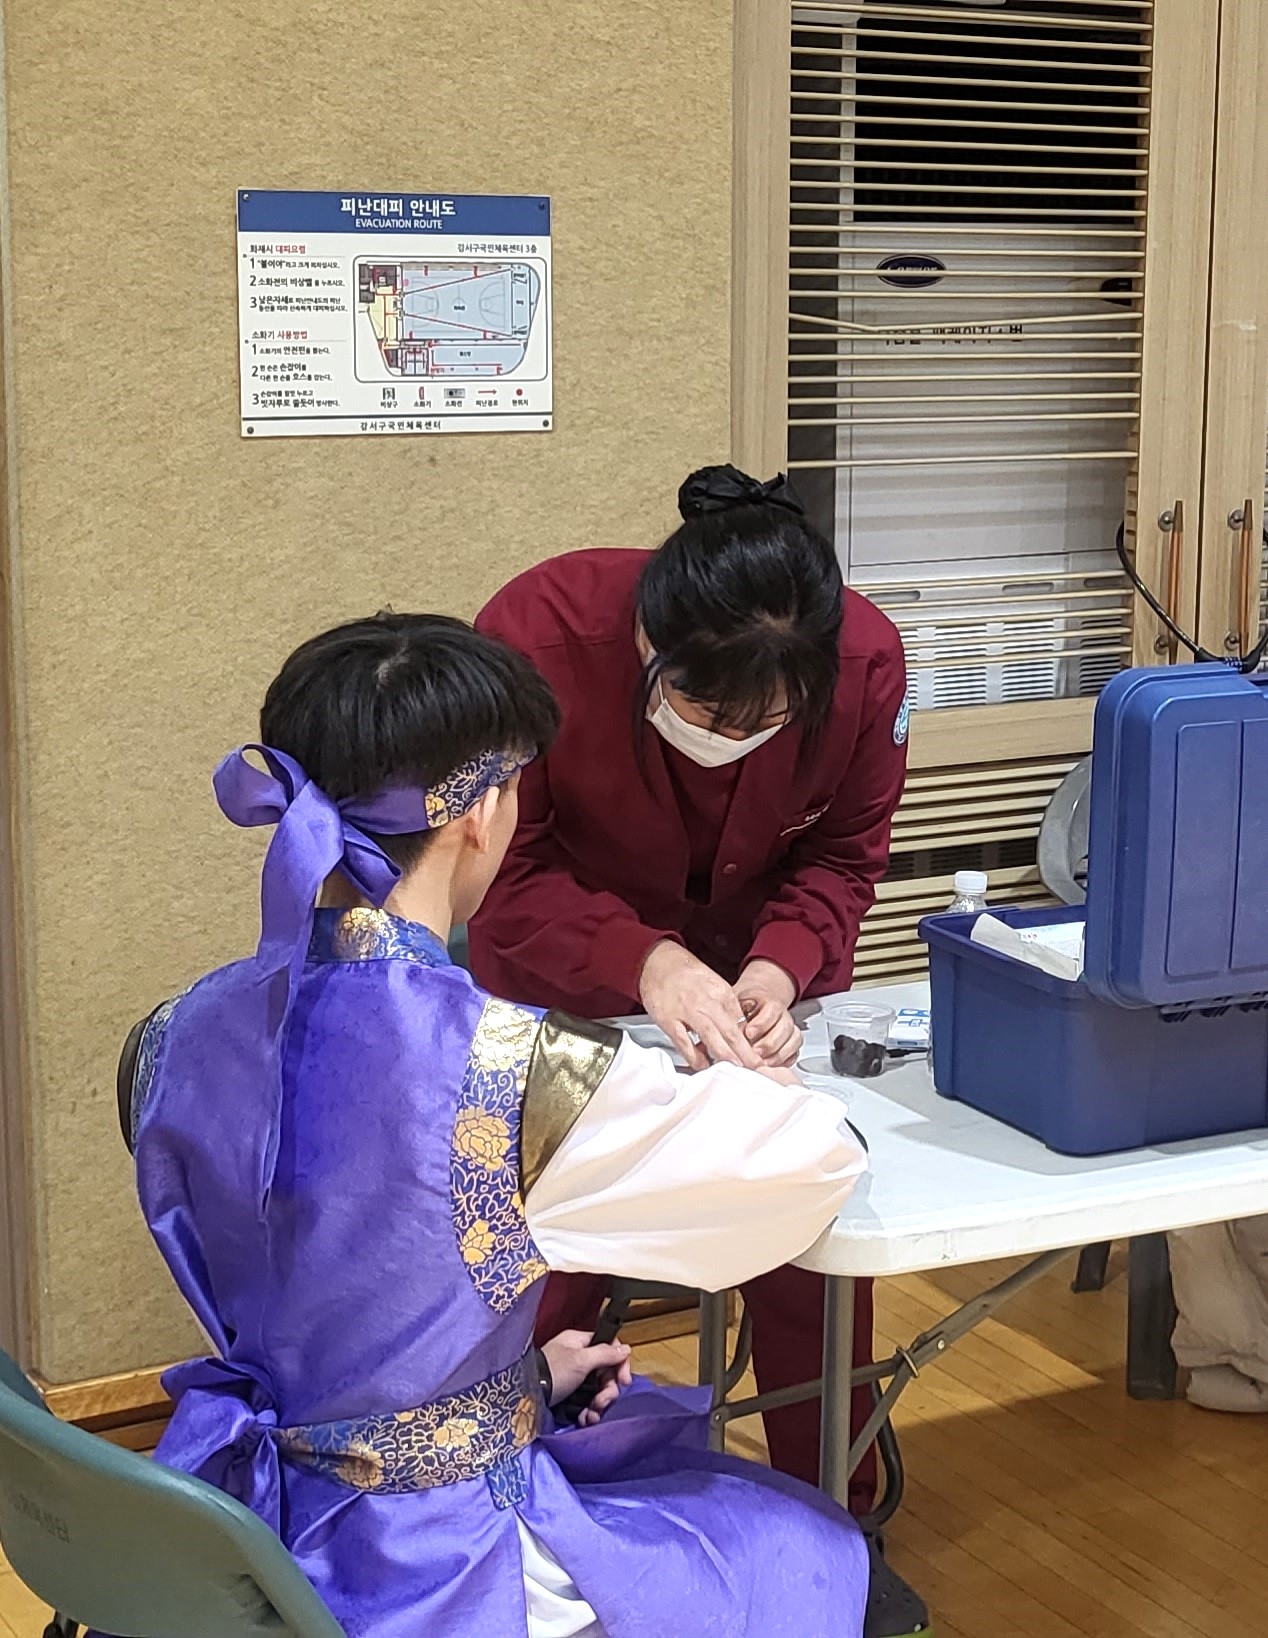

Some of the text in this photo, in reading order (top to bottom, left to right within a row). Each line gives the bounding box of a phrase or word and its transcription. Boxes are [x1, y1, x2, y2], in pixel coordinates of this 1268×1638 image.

[340, 198, 456, 218] 피난대피 안내도
[355, 218, 443, 229] EVACUATION ROUTE
[250, 244, 273, 254] 화재시
[457, 243, 524, 253] 강서구국민체육센터
[250, 258, 255, 269] 1
[249, 275, 257, 287] 2
[249, 296, 258, 308] 3
[251, 330, 308, 340] 소화기 사용방법
[251, 343, 257, 355] 1
[251, 365, 259, 377] 2
[251, 393, 260, 405] 3
[413, 400, 432, 408] 소화기
[360, 420, 442, 431] 강서구국민체육센터
